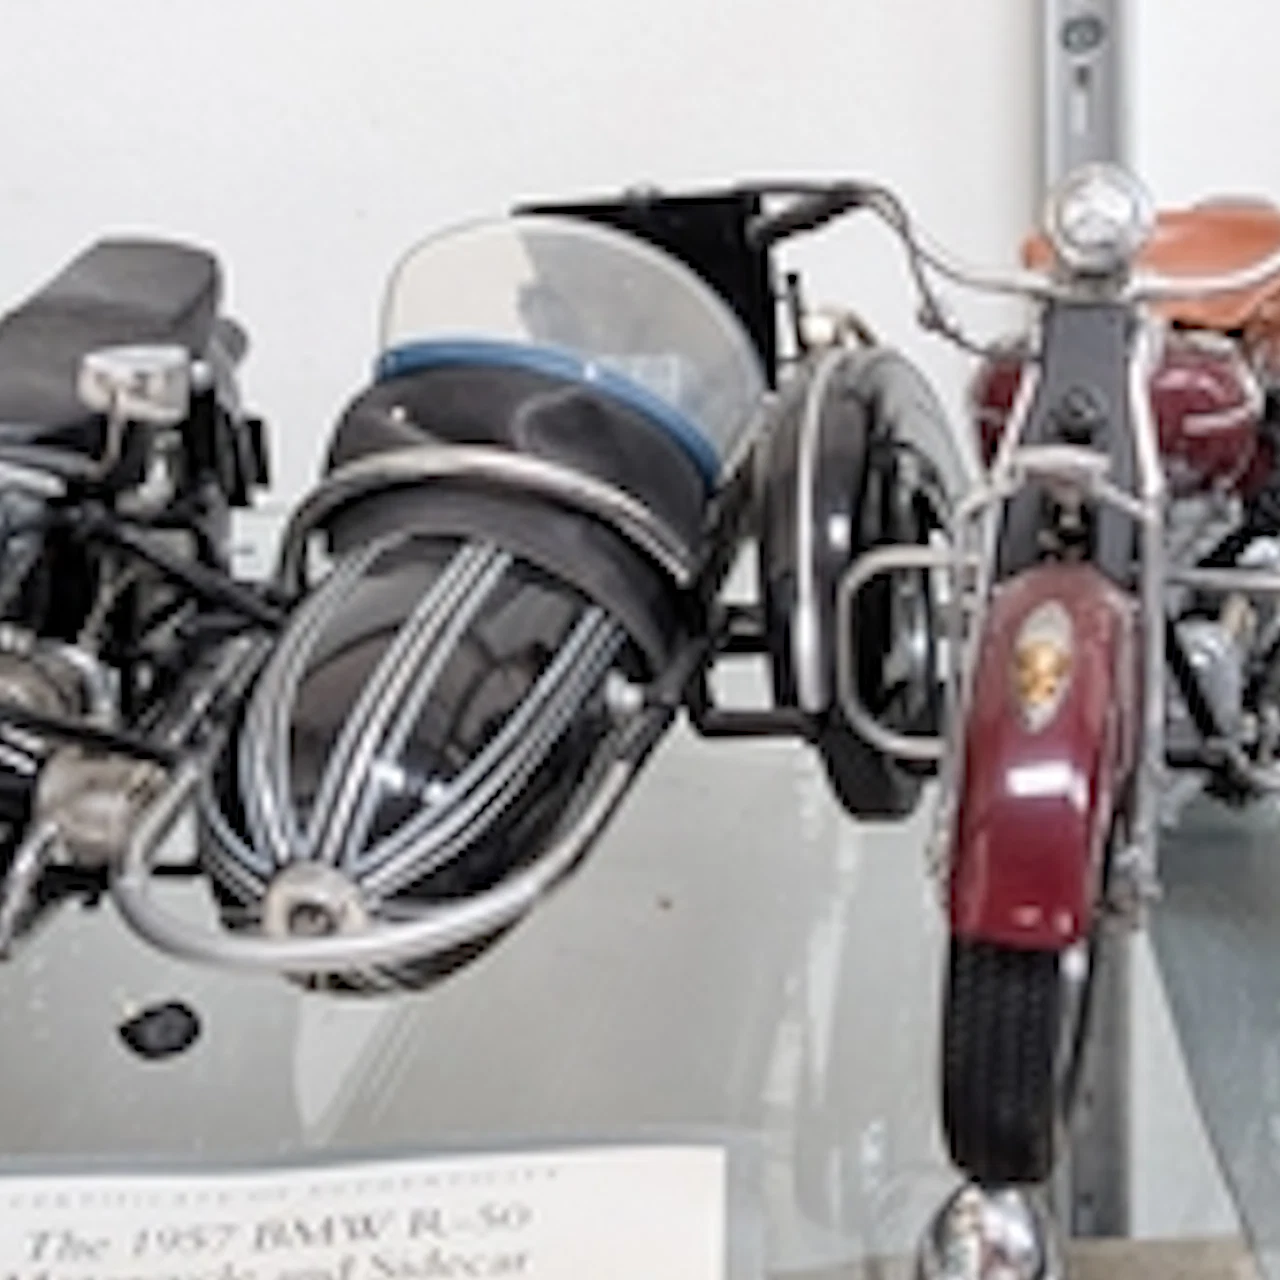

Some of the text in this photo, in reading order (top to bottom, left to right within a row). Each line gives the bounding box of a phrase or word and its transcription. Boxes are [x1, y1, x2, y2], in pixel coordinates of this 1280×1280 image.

[23, 1228, 111, 1263] The
[132, 1222, 240, 1258] 1957
[252, 1208, 395, 1252] BMW
